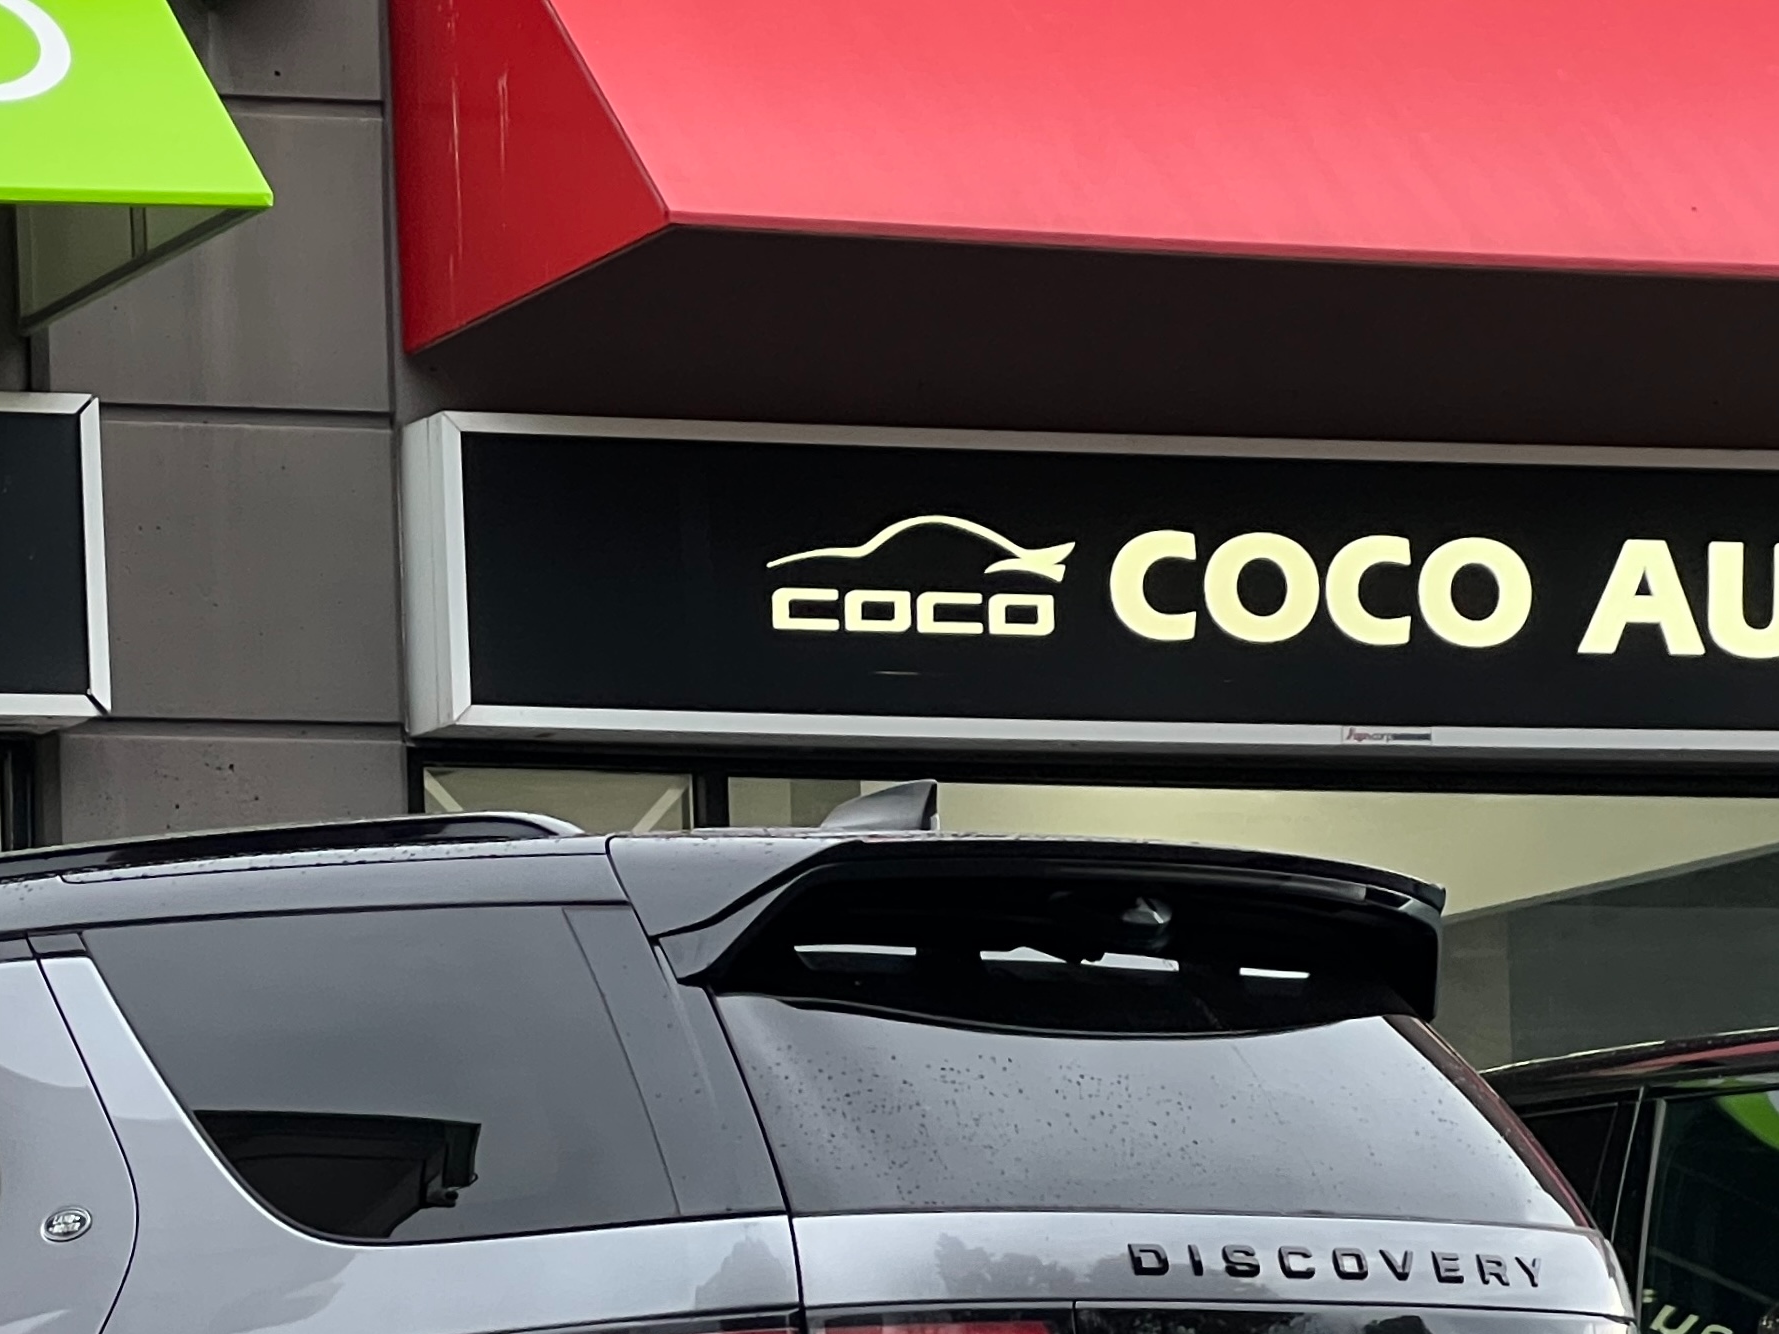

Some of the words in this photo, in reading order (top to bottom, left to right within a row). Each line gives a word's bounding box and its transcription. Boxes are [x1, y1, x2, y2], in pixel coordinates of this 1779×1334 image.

[771, 587, 1055, 637] COCO
[1109, 529, 1533, 648] COCO
[1127, 1243, 1542, 1287] DISCOVERY
